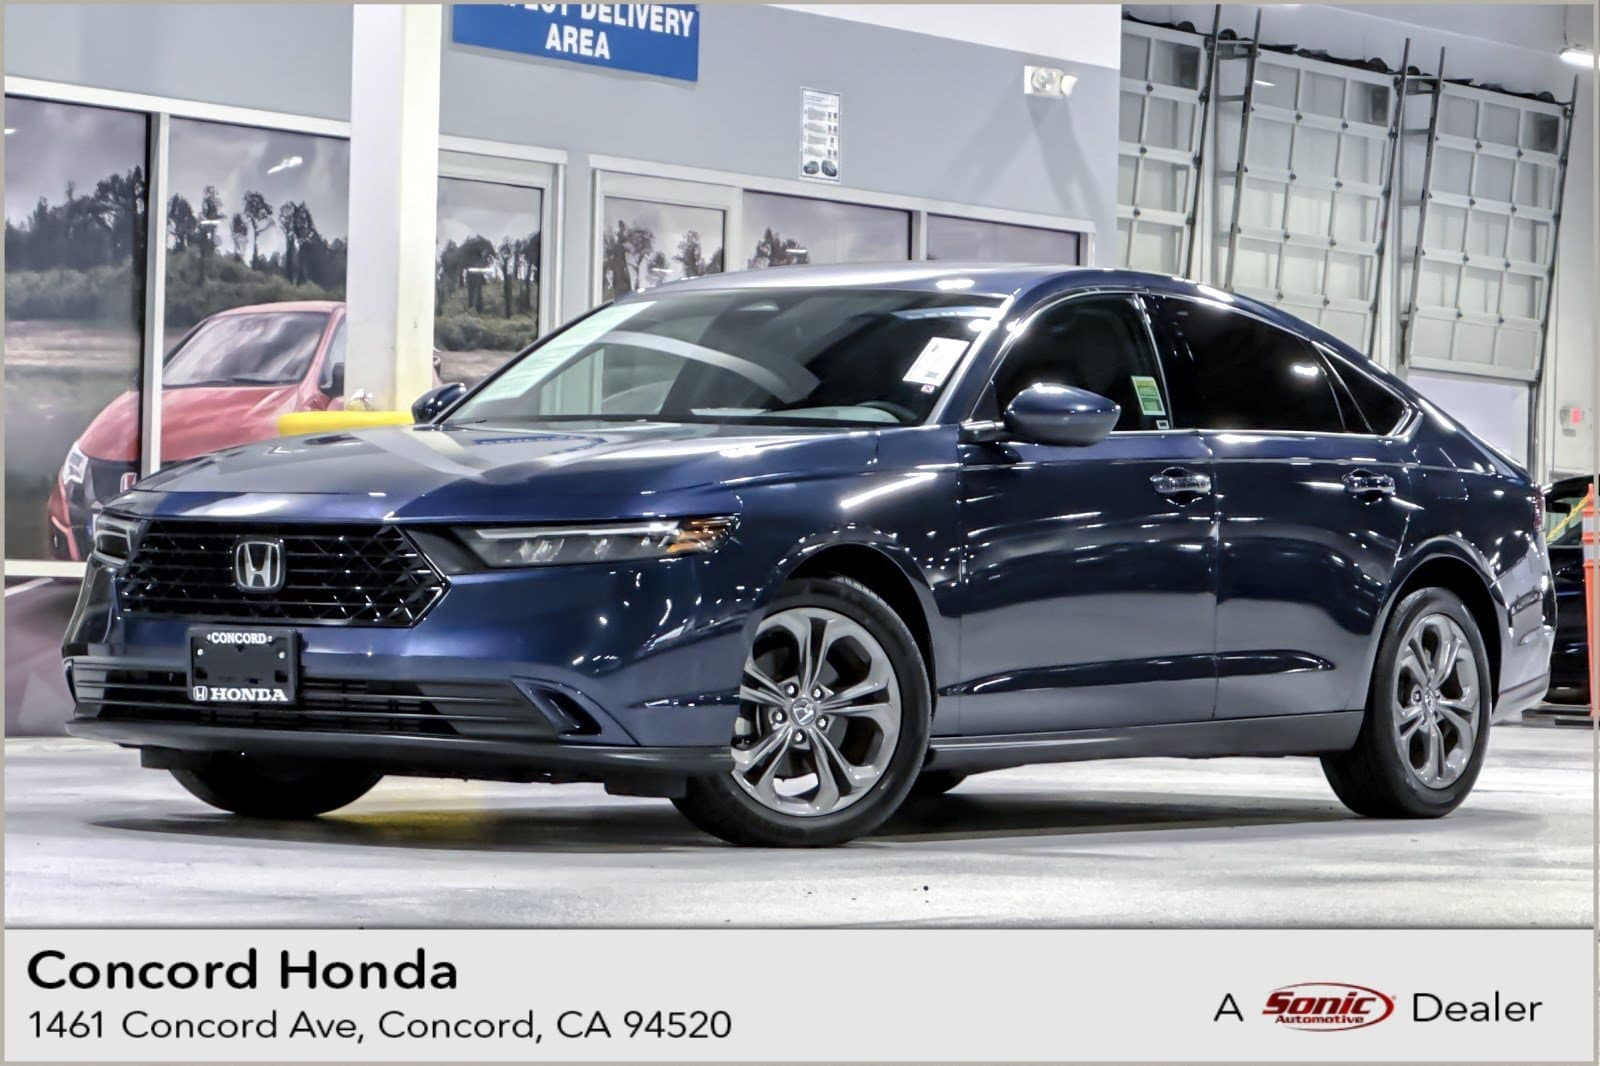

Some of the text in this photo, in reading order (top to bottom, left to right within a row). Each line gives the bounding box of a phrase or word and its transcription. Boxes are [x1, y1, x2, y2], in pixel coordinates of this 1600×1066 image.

[581, 4, 694, 37] DELIVERY
[545, 23, 610, 59] AREA
[211, 632, 267, 644] CONCORD
[210, 688, 288, 702] HONDA
